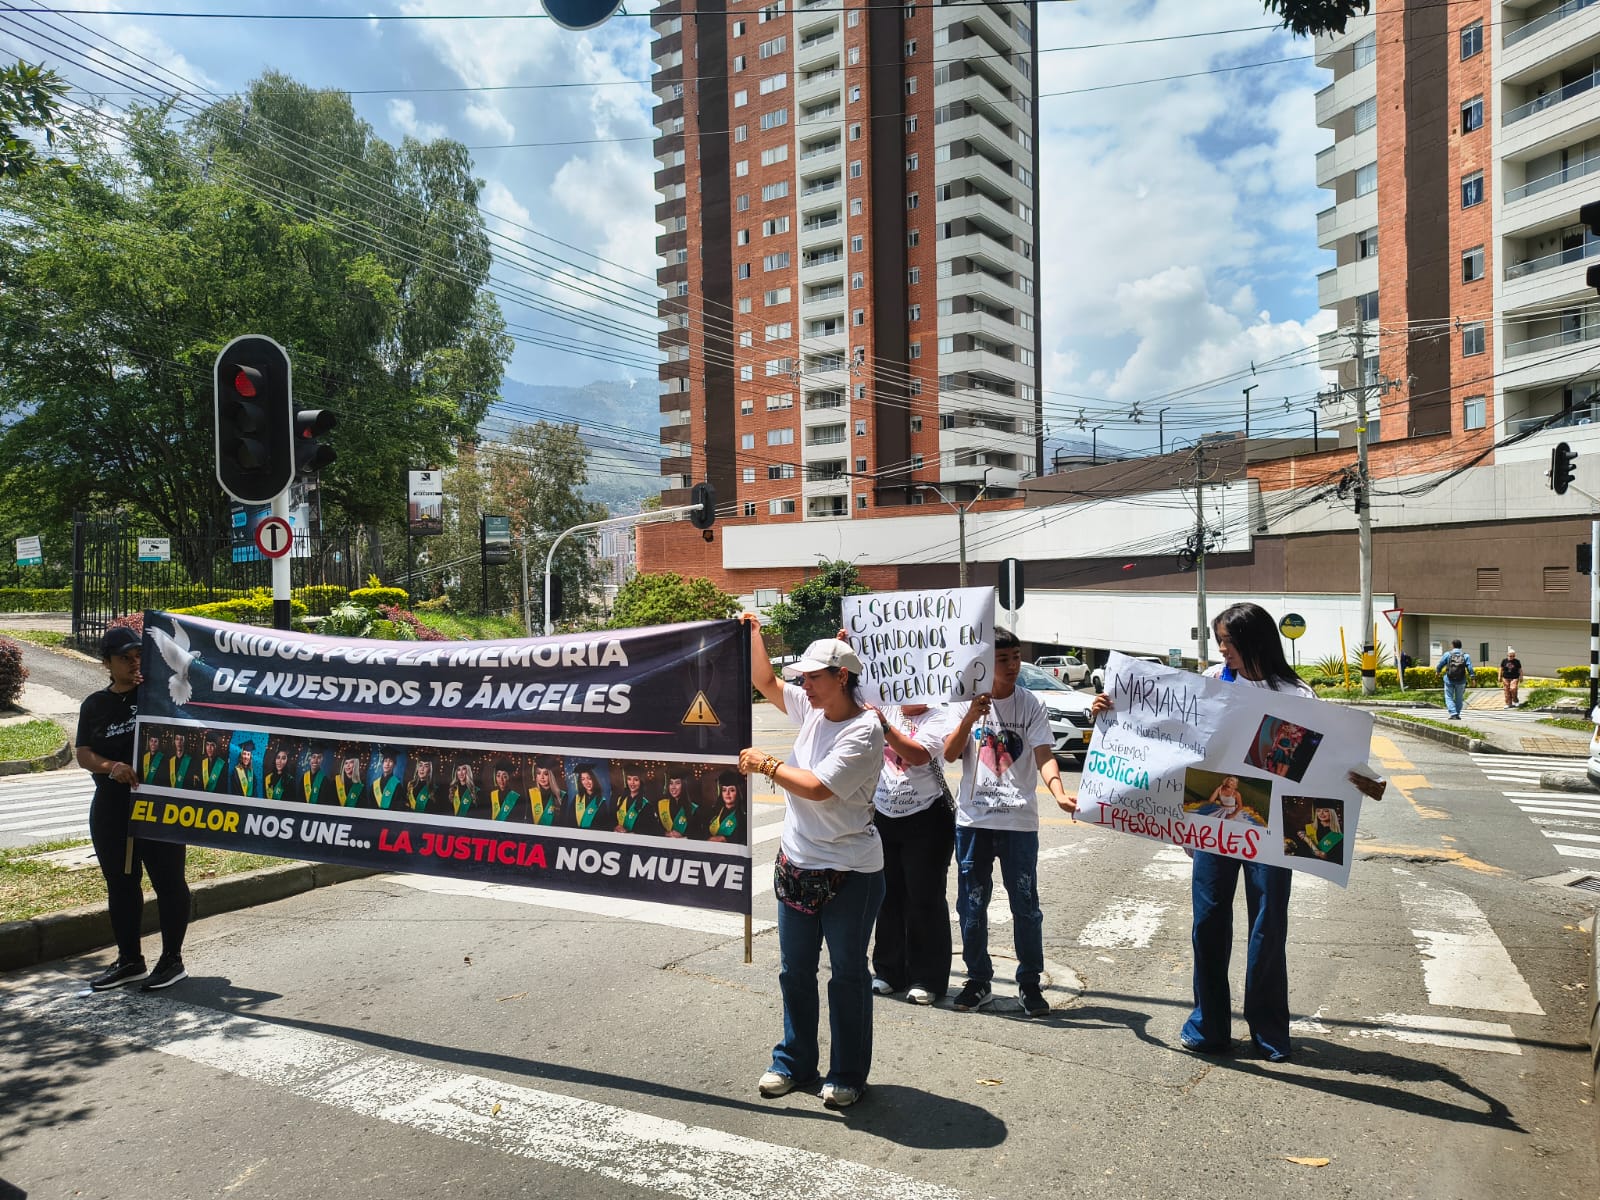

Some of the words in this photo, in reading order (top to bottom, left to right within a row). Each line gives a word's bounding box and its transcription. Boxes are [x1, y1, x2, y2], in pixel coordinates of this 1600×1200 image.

[214, 629, 324, 661] UNIDOS
[322, 645, 398, 665] POR
[396, 648, 443, 667] LA
[959, 622, 983, 646] EN
[927, 650, 955, 670] DE
[212, 667, 258, 694] DE
[255, 671, 422, 706] NUESTROS
[428, 681, 463, 708] 16
[464, 675, 632, 714] ÁNGELES
[1166, 778, 1183, 793] NO
[131, 801, 158, 823] EL
[162, 804, 240, 832] DOLOR
[244, 814, 295, 840] NOS
[300, 820, 371, 849] UNE...
[378, 828, 414, 854] LA
[419, 833, 547, 868] JUSTICIA
[555, 846, 621, 876] NOS
[629, 854, 745, 891] MUEVE
